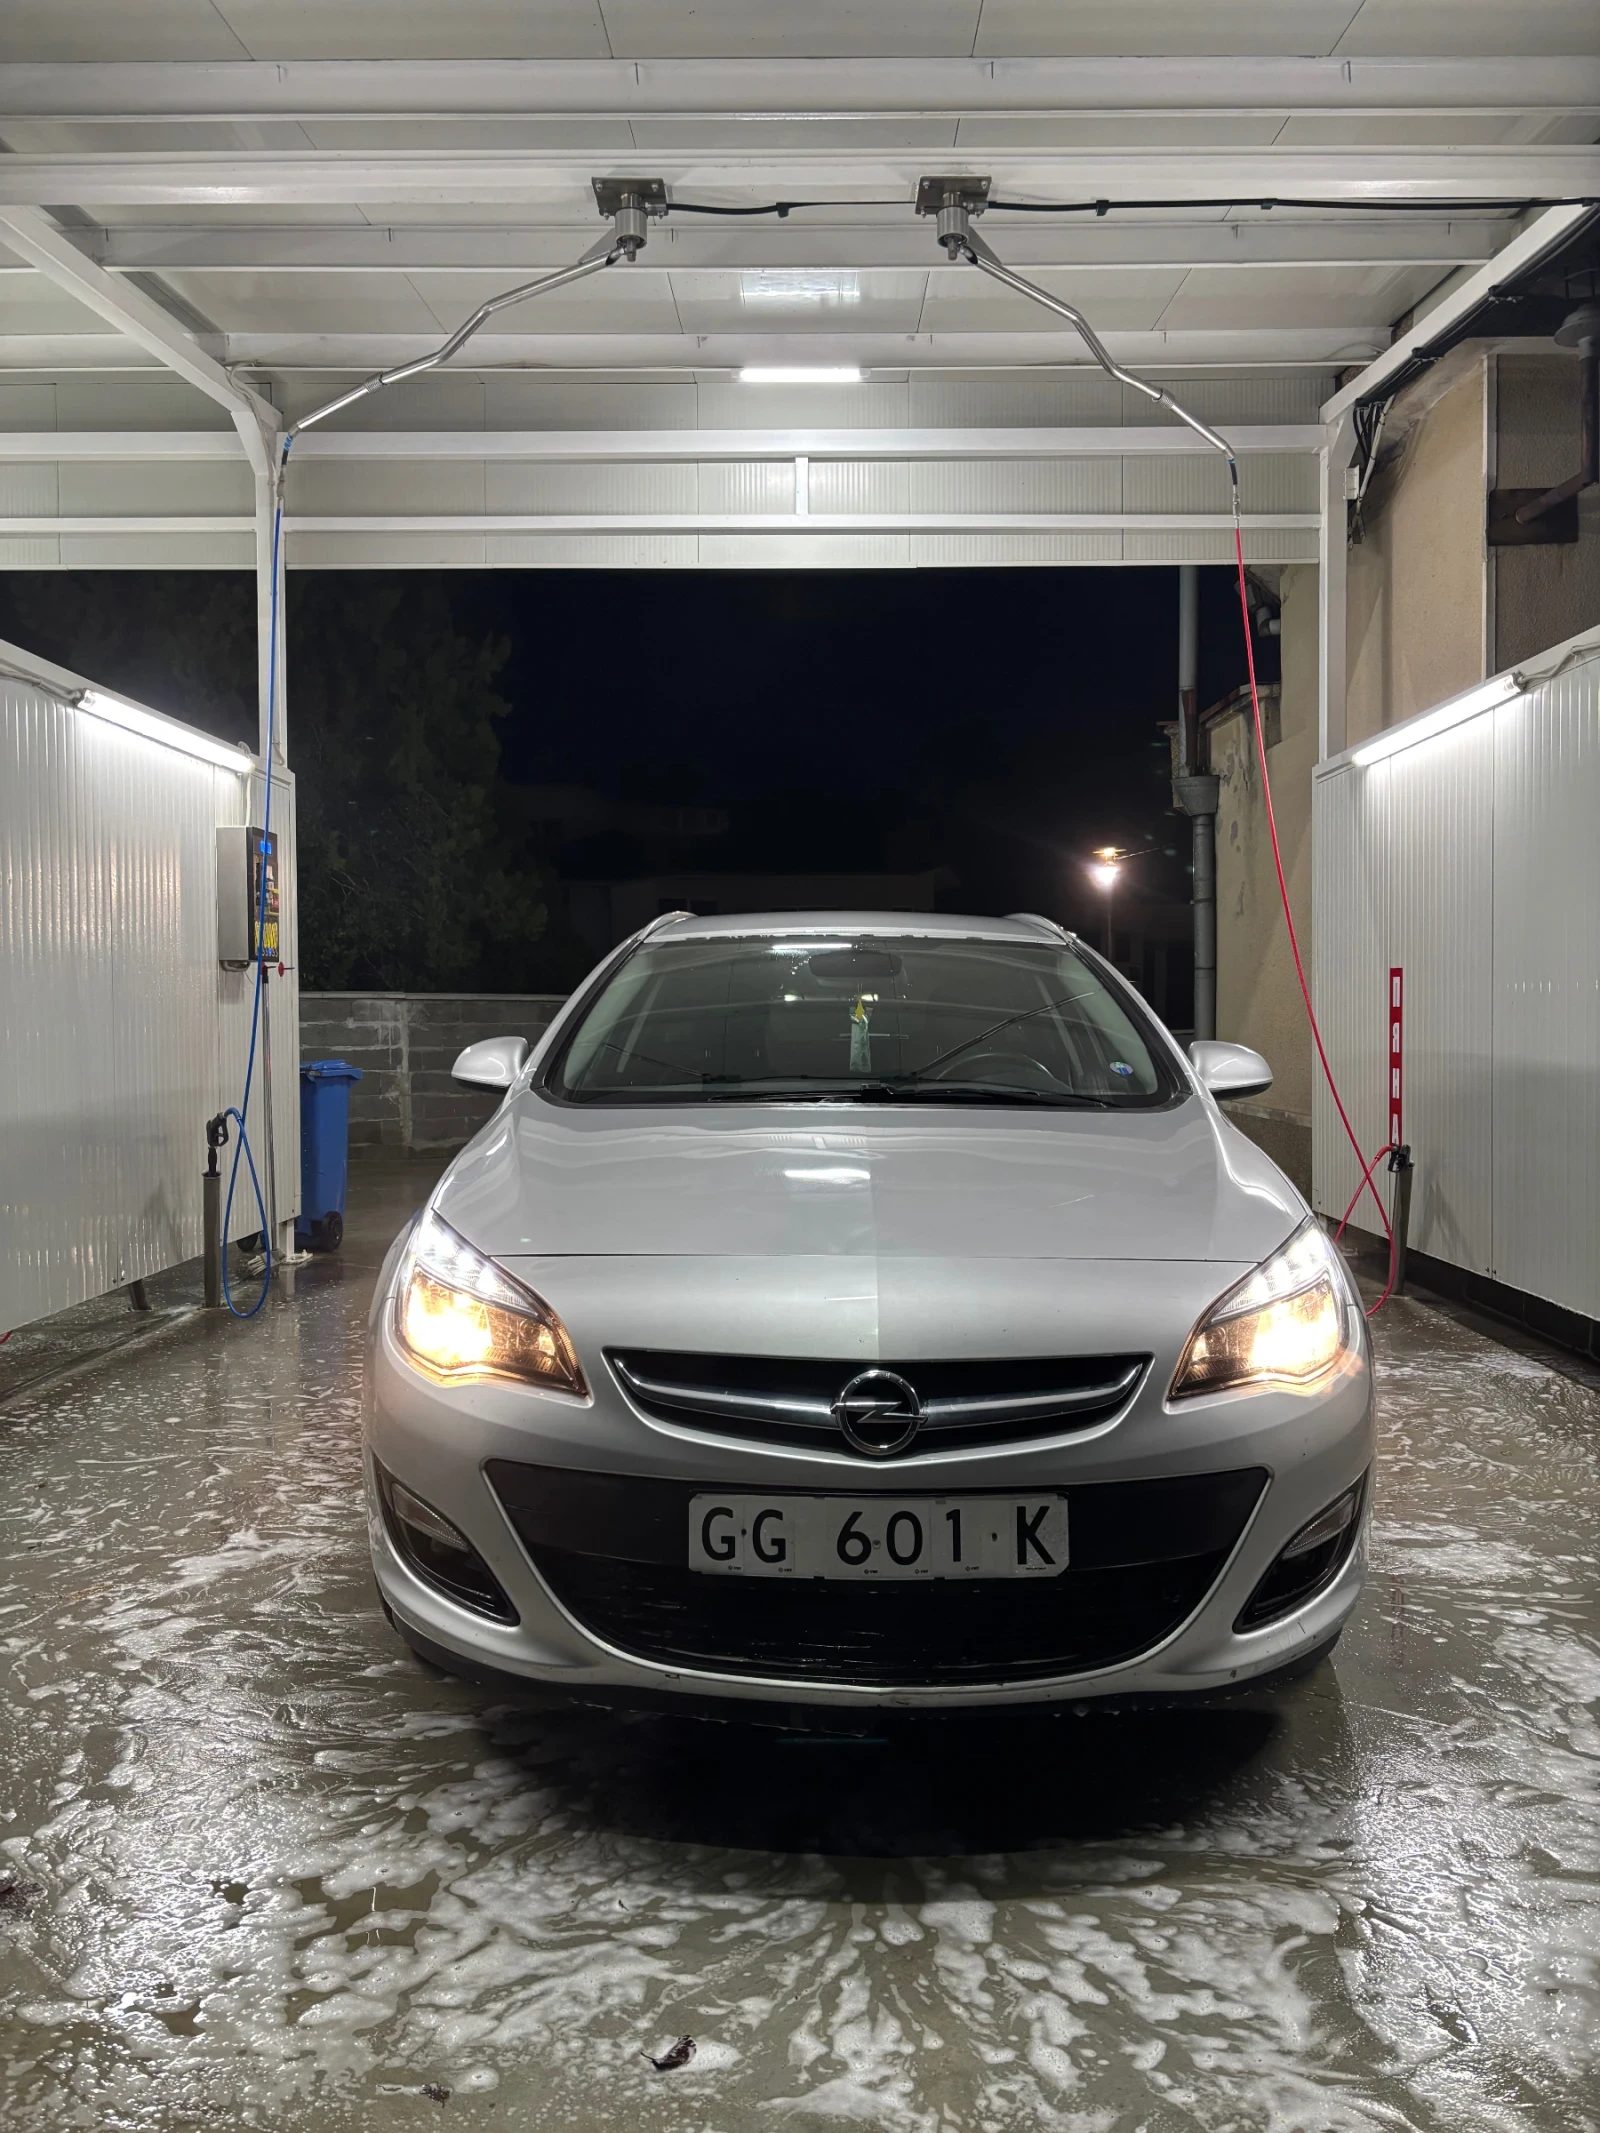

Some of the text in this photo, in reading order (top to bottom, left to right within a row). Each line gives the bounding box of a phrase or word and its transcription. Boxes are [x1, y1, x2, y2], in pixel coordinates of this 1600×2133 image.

[1392, 976, 1400, 1145] ПЯНА
[701, 1505, 1056, 1565] GG 601 K
